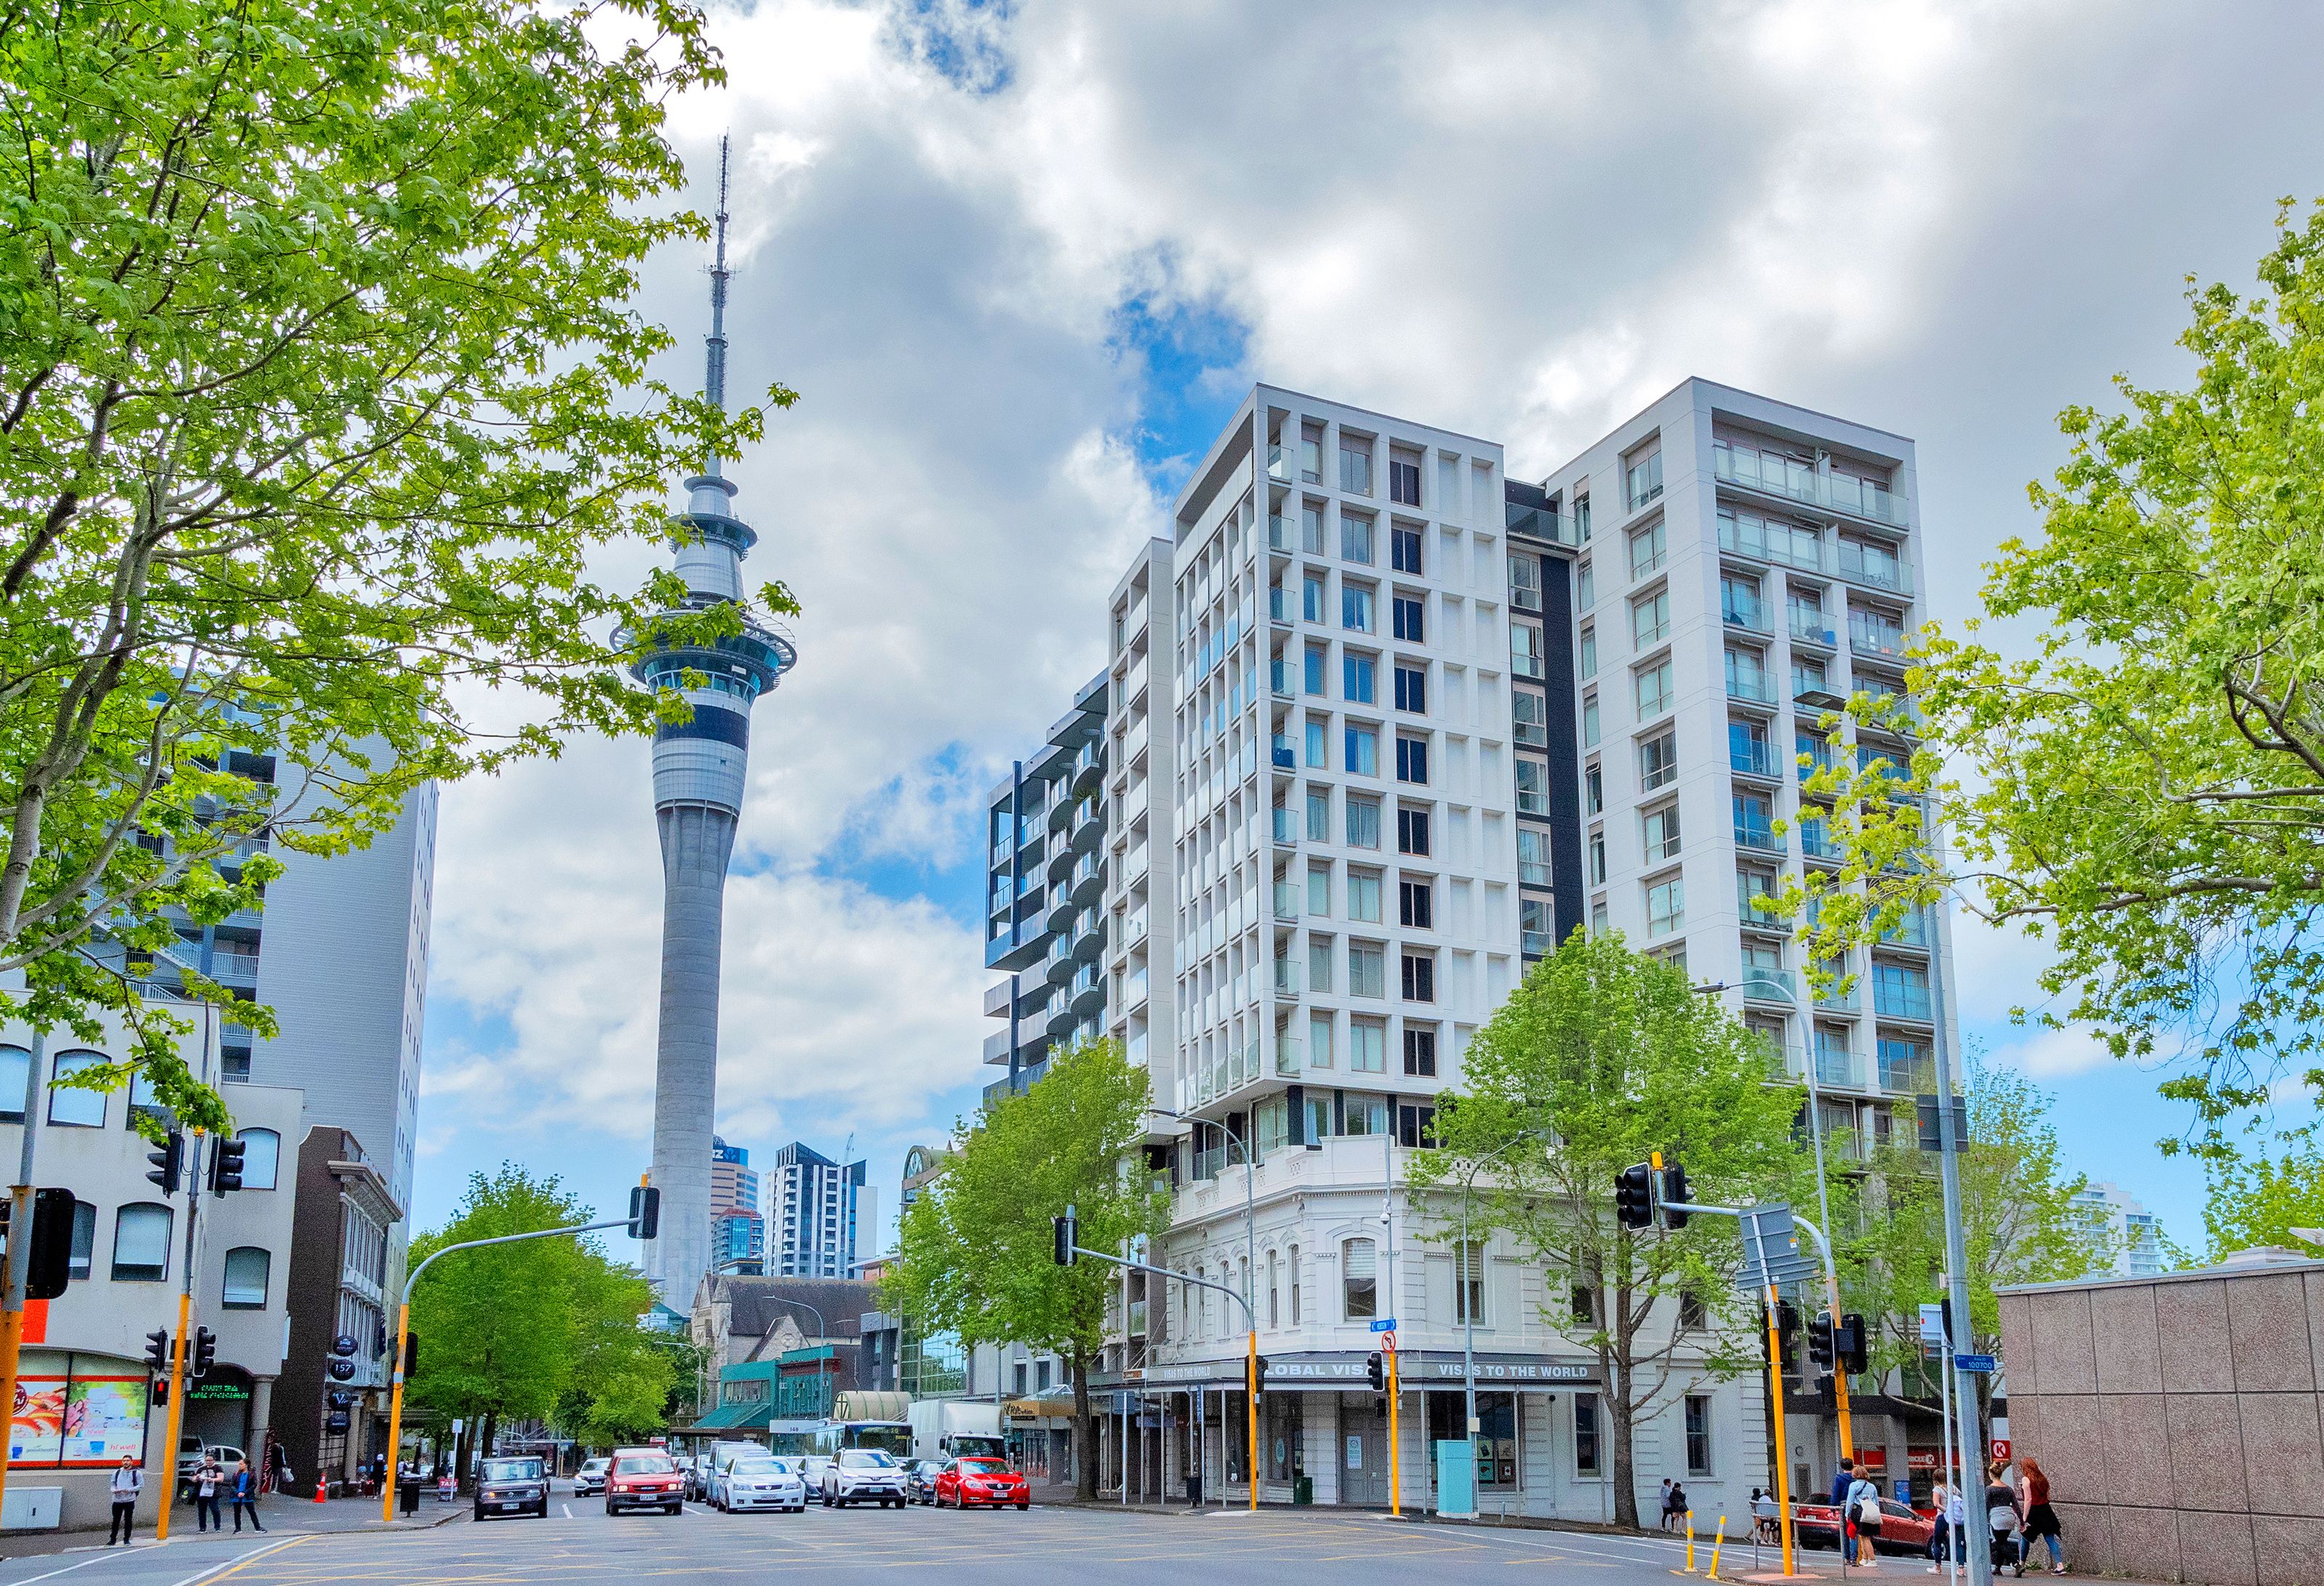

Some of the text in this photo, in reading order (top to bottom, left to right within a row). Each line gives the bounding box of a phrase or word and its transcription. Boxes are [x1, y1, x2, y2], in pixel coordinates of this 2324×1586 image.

[1164, 1365, 1211, 1379] VISAS TO THE WORLD
[1264, 1364, 1390, 1376] LOBAL VISS
[1438, 1365, 1588, 1378] VISS TO THE WORLD
